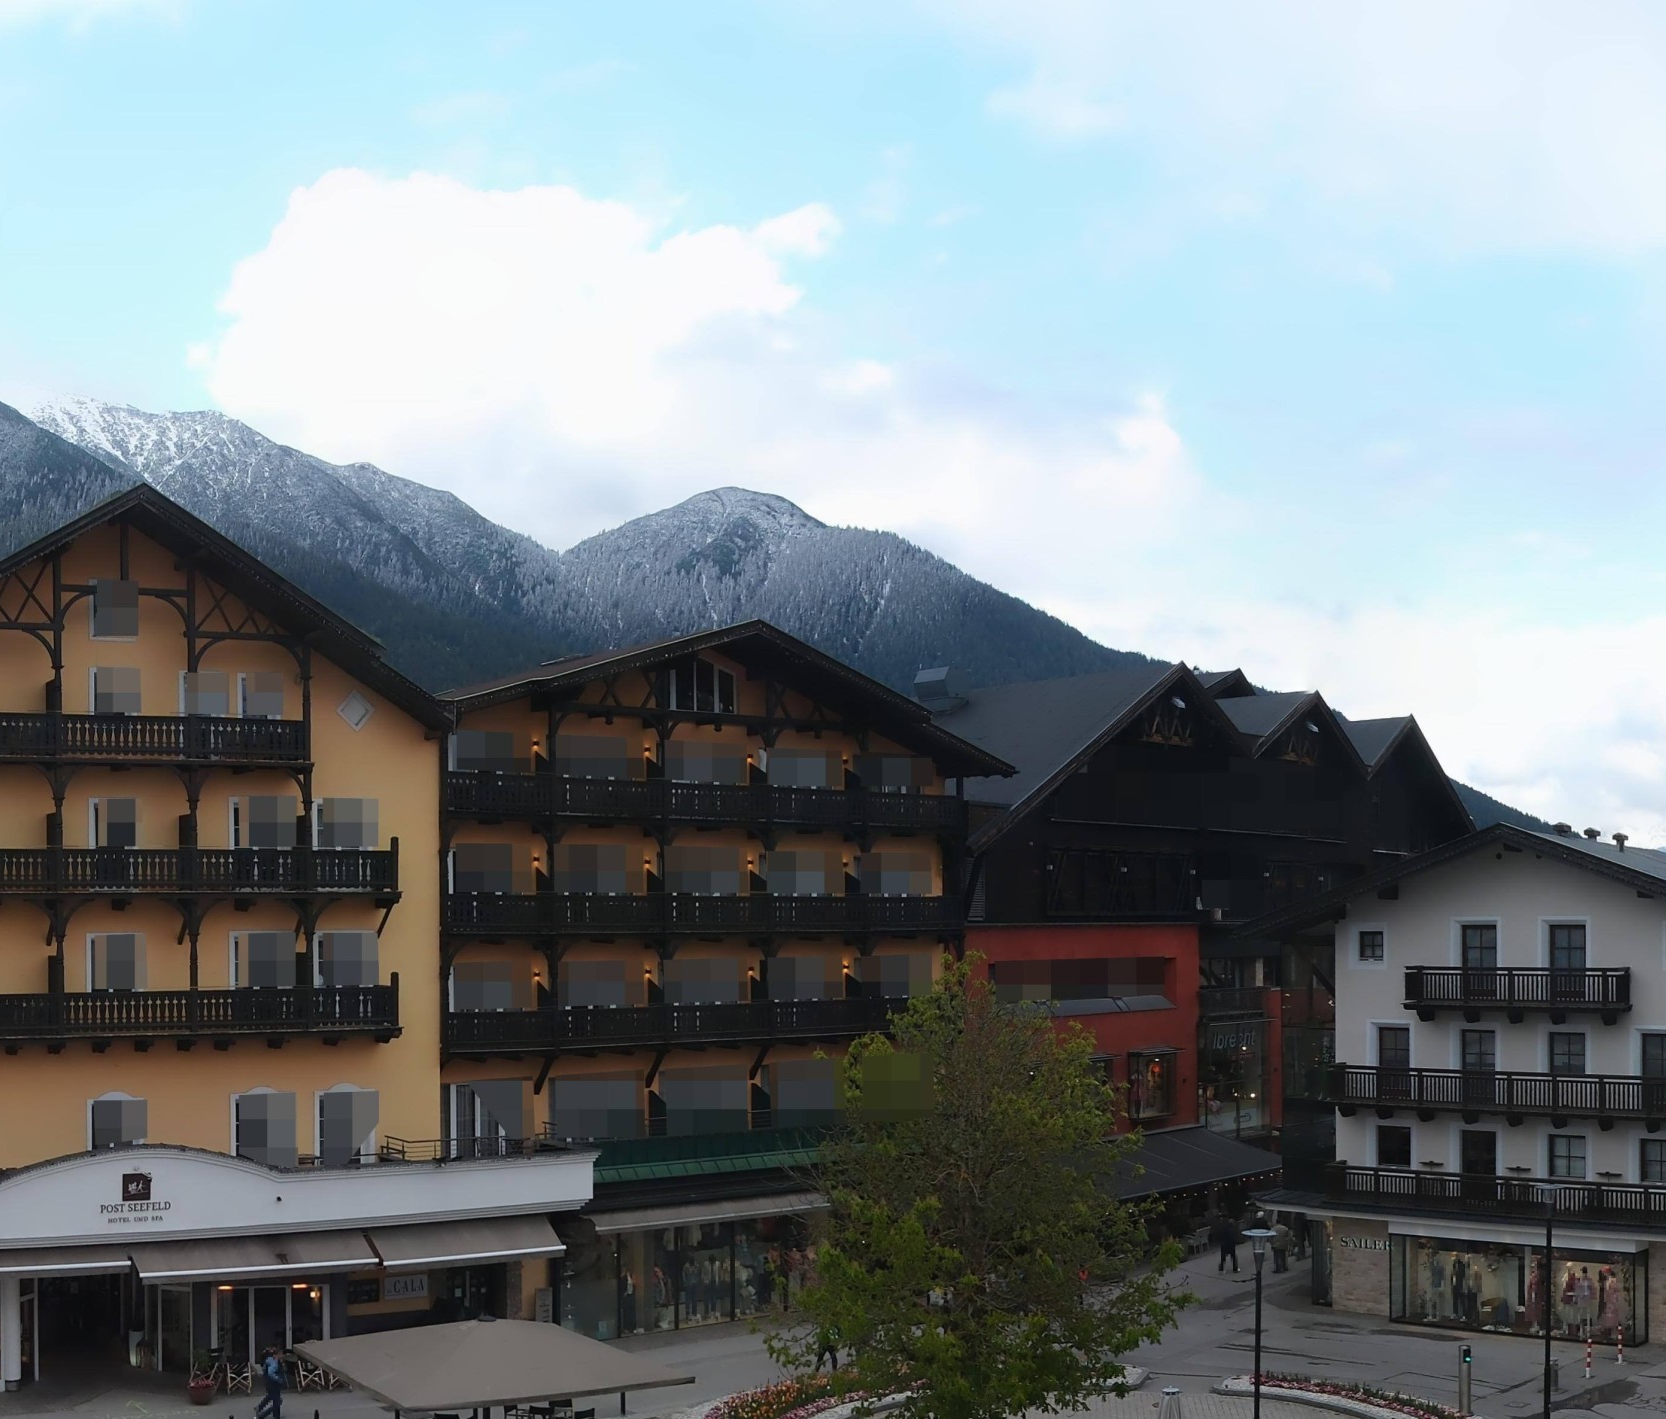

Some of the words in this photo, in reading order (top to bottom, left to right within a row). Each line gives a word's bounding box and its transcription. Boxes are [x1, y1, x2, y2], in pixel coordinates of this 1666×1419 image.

[100, 1203, 126, 1214] POST
[127, 1201, 171, 1212] SEEFELD
[393, 1278, 424, 1293] CALA
